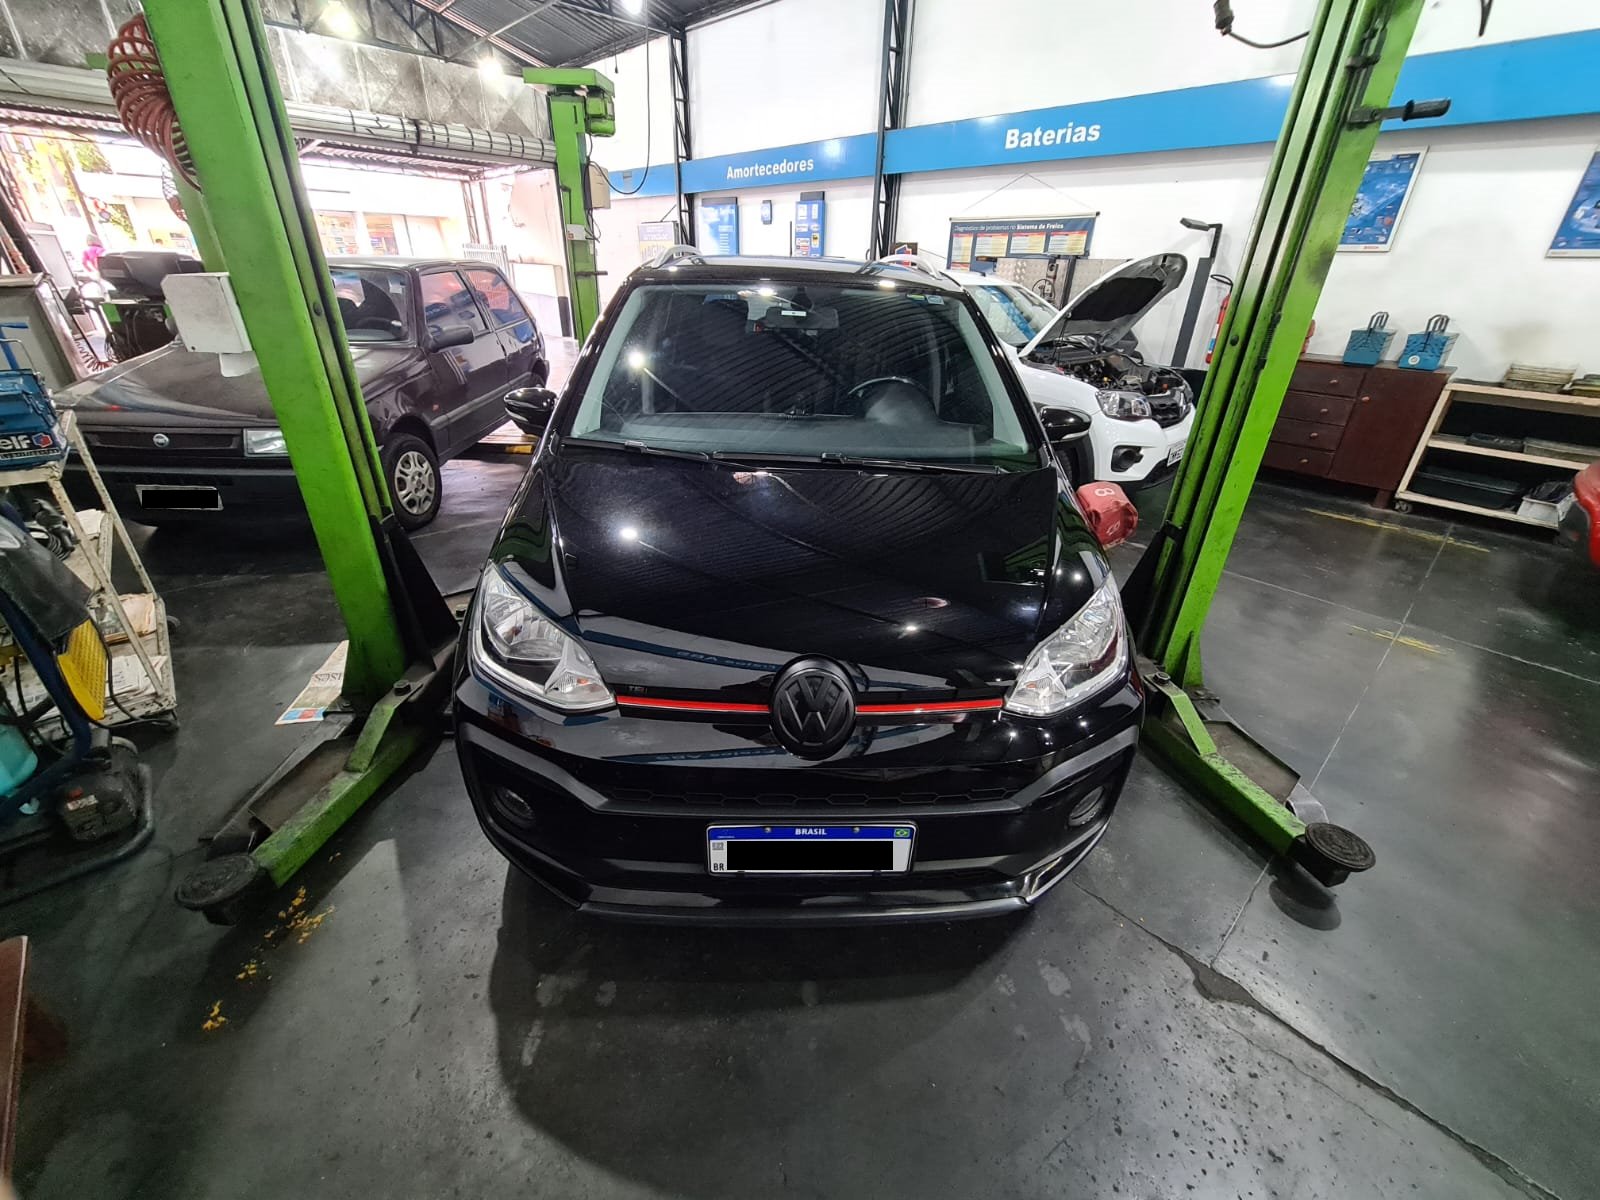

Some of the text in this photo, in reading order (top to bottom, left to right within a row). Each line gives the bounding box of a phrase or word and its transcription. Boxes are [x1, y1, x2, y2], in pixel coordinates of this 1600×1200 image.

[1004, 121, 1101, 150] Baterias
[726, 156, 814, 180] Amortecedores
[1038, 222, 1046, 230] de
[1047, 221, 1064, 229] Freios
[0, 435, 31, 450] elf
[795, 827, 827, 835] BRASIL
[713, 862, 725, 872] BR
